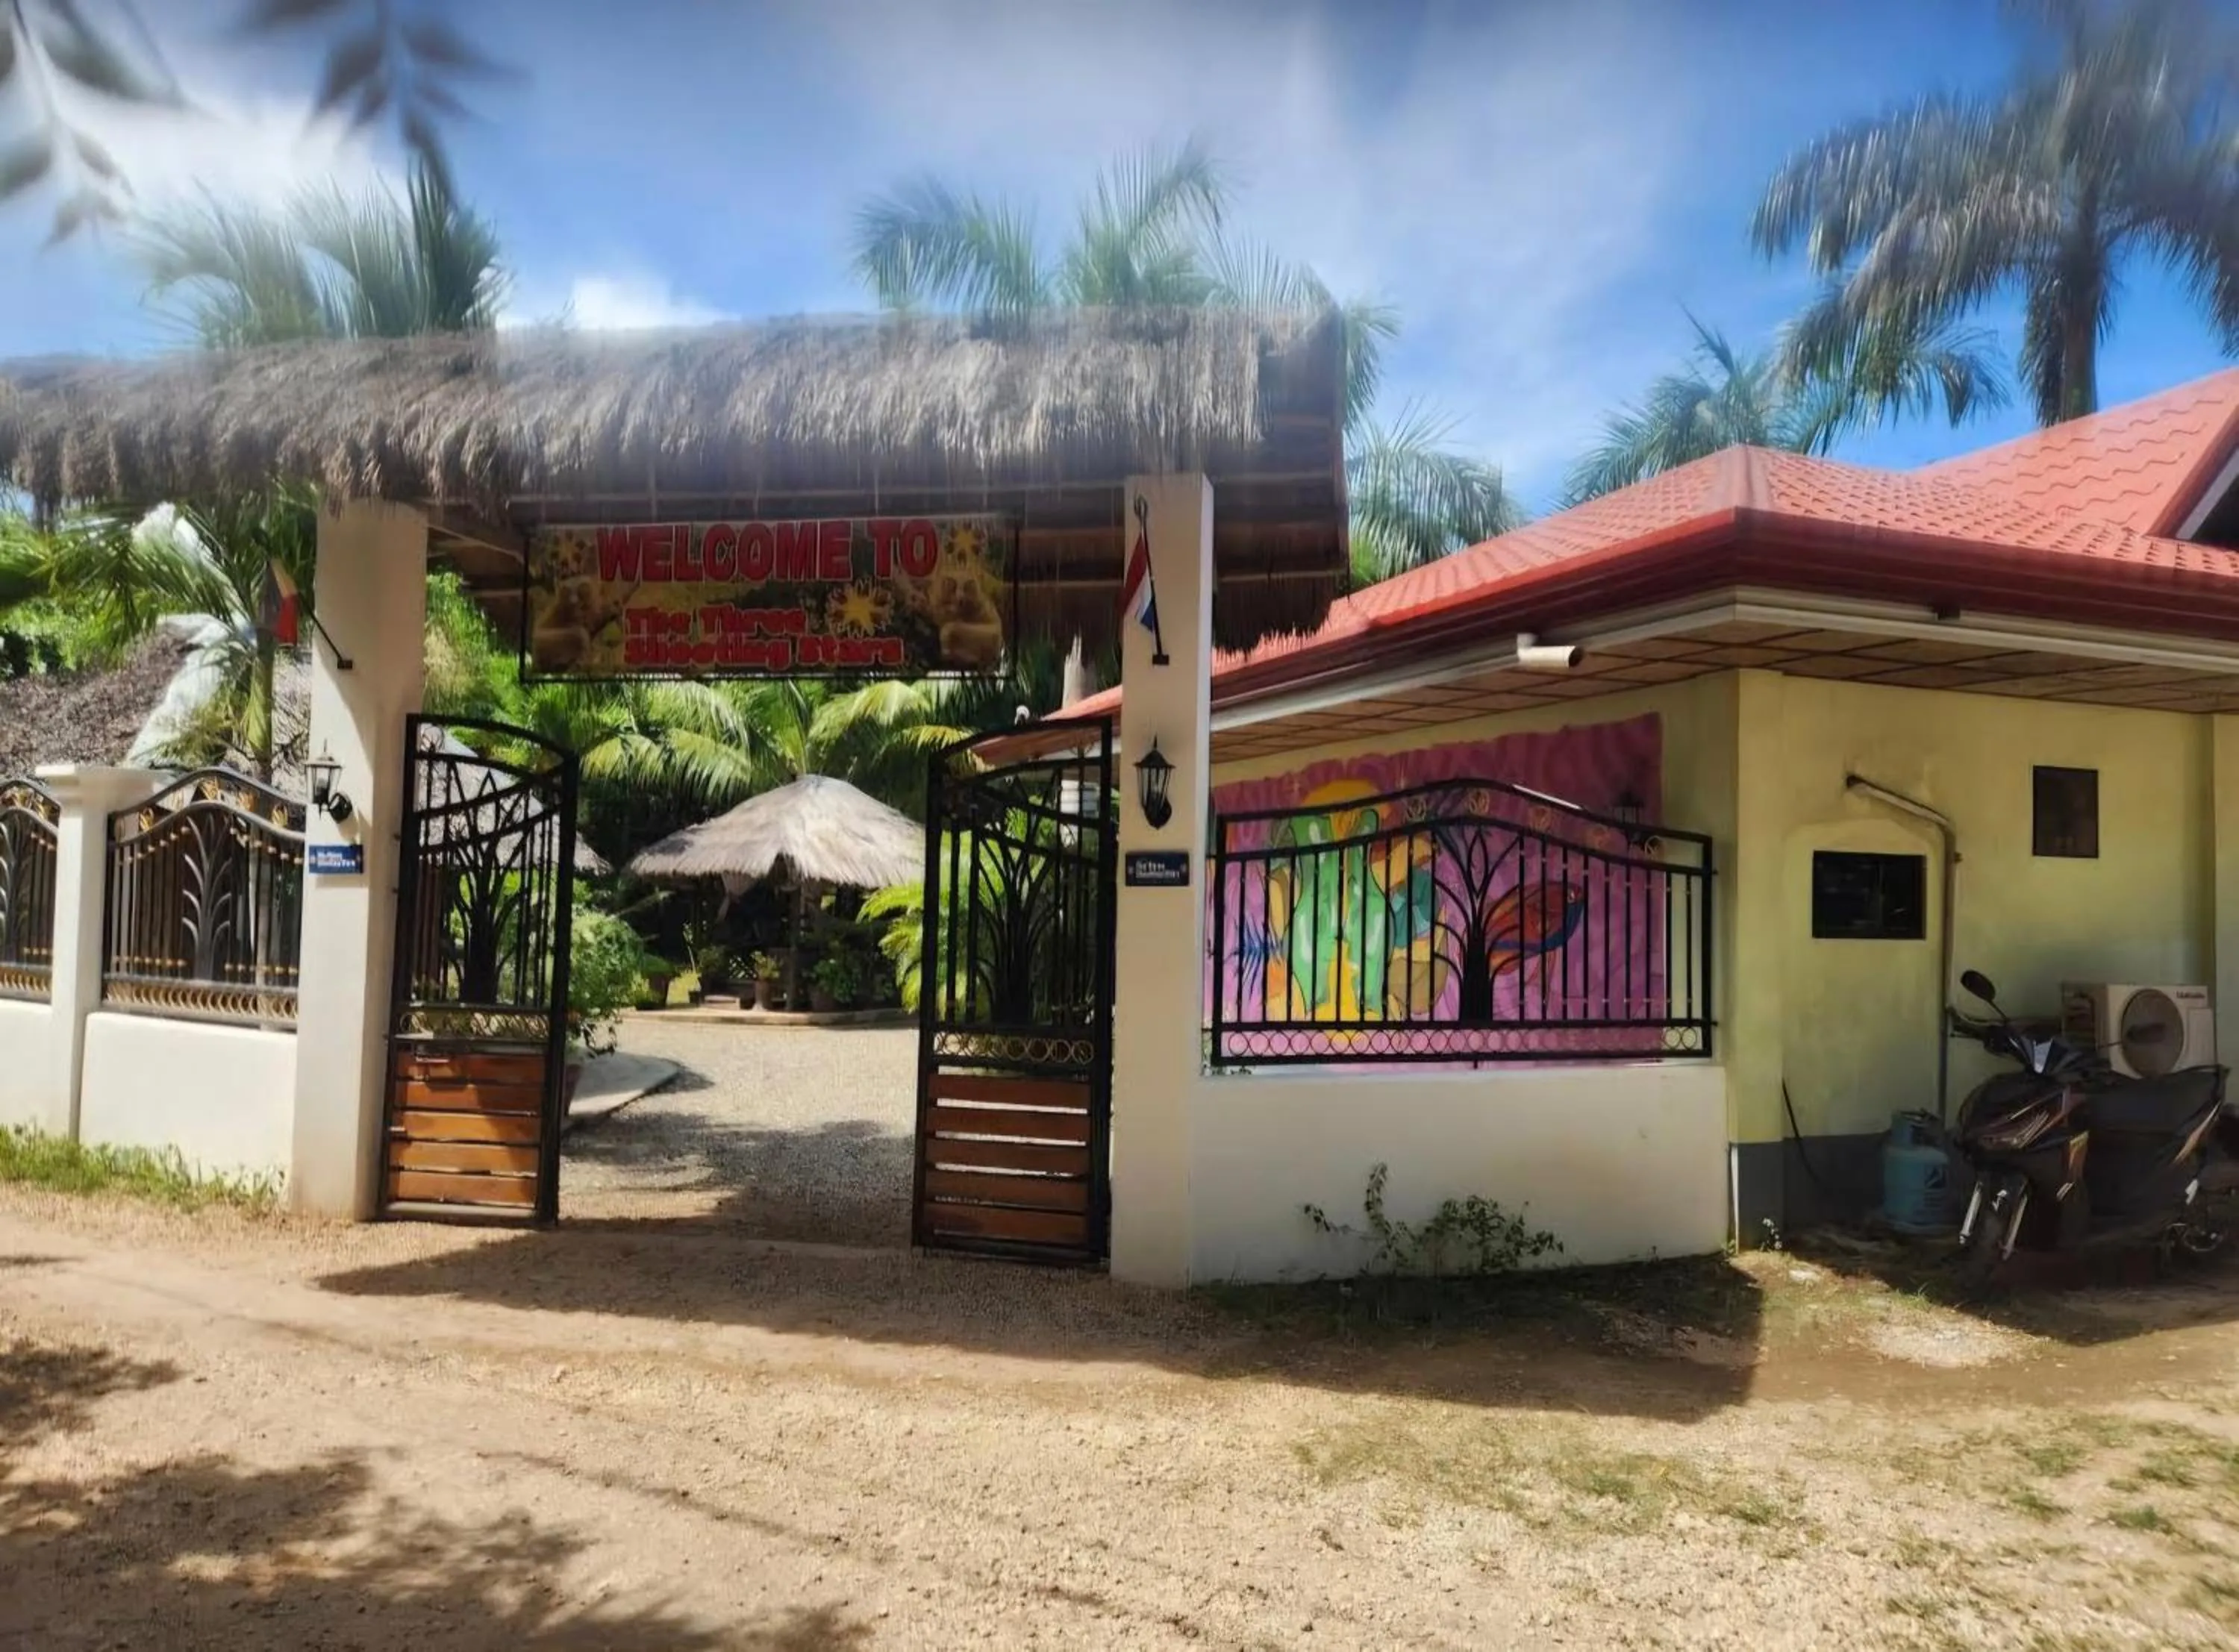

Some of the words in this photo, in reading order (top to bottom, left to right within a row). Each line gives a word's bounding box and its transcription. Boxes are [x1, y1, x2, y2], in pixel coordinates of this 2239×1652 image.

[599, 522, 852, 581] WELCOME
[868, 520, 938, 578] TO
[624, 606, 692, 636] The
